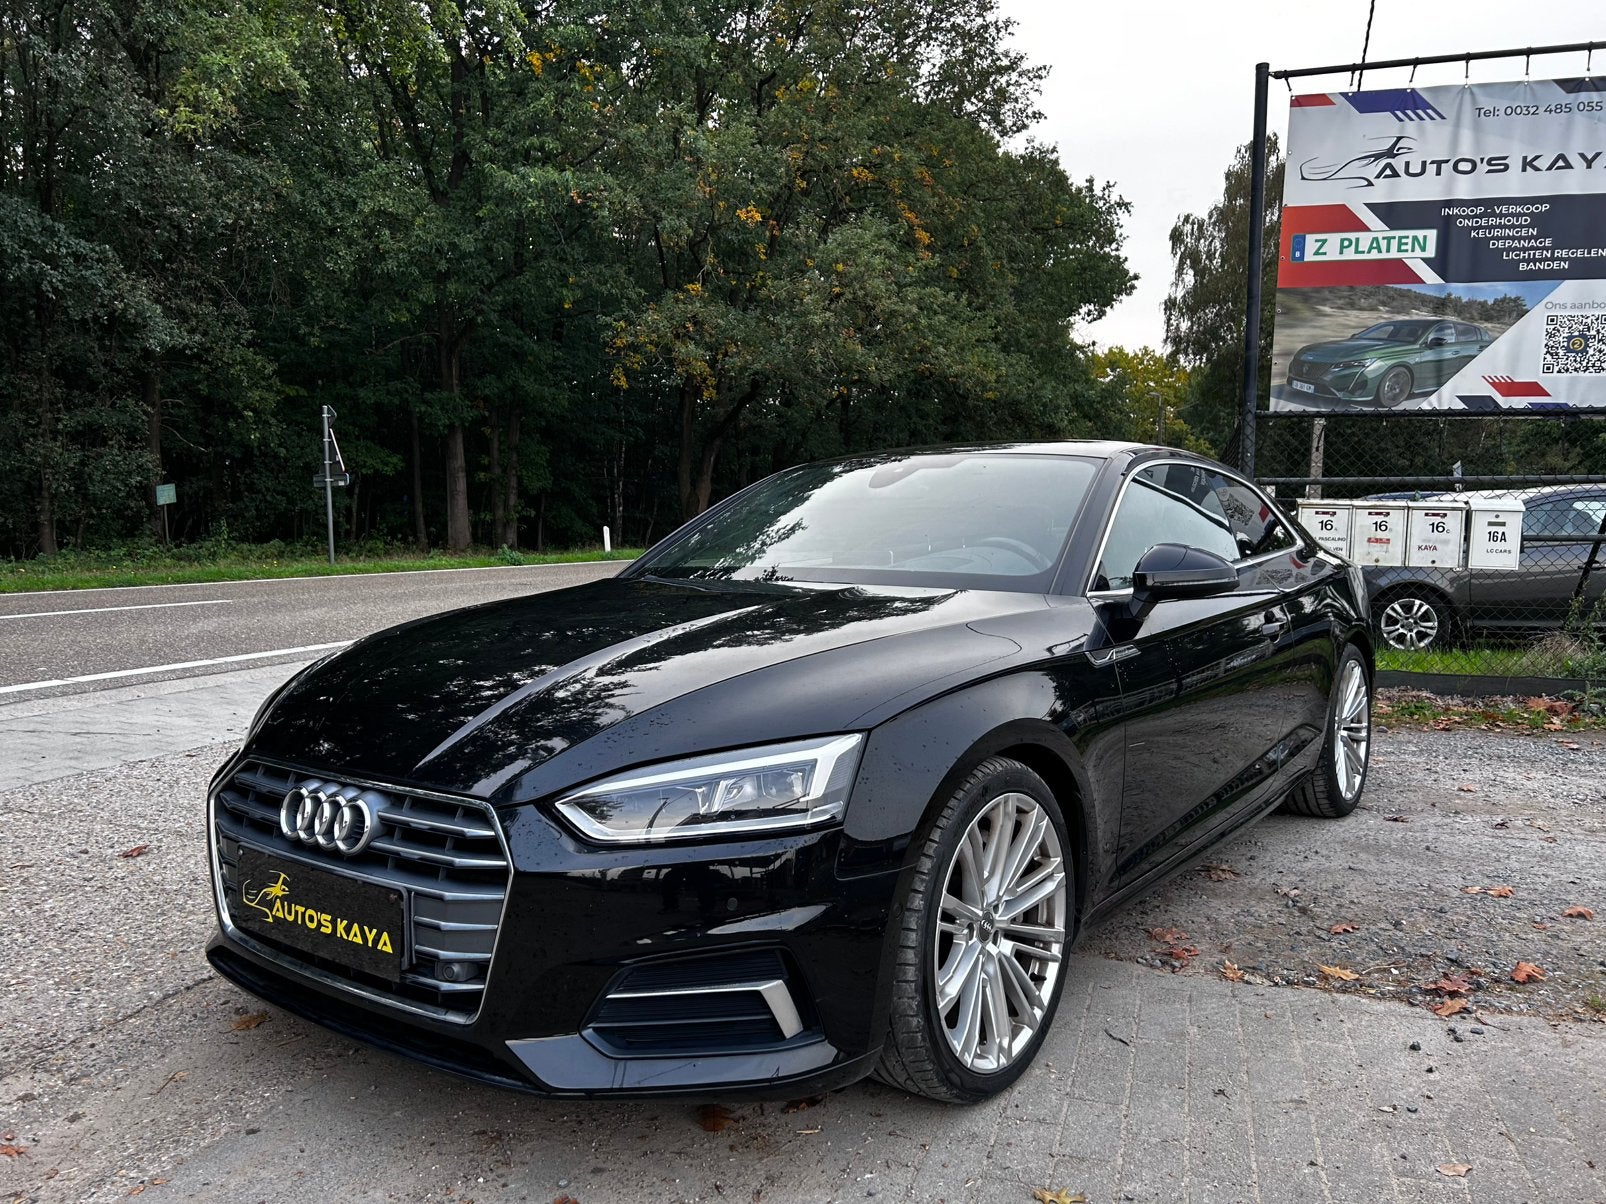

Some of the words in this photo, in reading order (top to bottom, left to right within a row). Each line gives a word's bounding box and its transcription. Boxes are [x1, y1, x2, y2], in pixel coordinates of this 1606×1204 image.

[1475, 106, 1500, 118] Tel:
[1504, 104, 1539, 117] 0032
[1543, 102, 1572, 115] 485
[1577, 101, 1604, 113] 055
[1373, 155, 1510, 179] AUTO'S
[1521, 151, 1606, 173] KAY
[1441, 206, 1485, 216] INKOOP
[1494, 204, 1550, 214] VERKOOP
[1456, 216, 1531, 227] ONDERHOUD
[1470, 227, 1538, 238] KEURINGEN
[1312, 238, 1328, 256] Z
[1338, 235, 1428, 255] PLATEN
[1489, 238, 1553, 248] DEPANAGE
[1502, 250, 1551, 260] LICHTEN
[1554, 248, 1606, 258] REGELEN
[1519, 261, 1569, 271] BANDEN
[1544, 301, 1567, 310] Ons
[1318, 519, 1334, 531] 16
[1372, 520, 1388, 532] 16
[1429, 521, 1445, 533] 16
[1487, 530, 1507, 542] 16A
[272, 898, 333, 934] AUTO'S
[336, 918, 394, 954] KAYA
